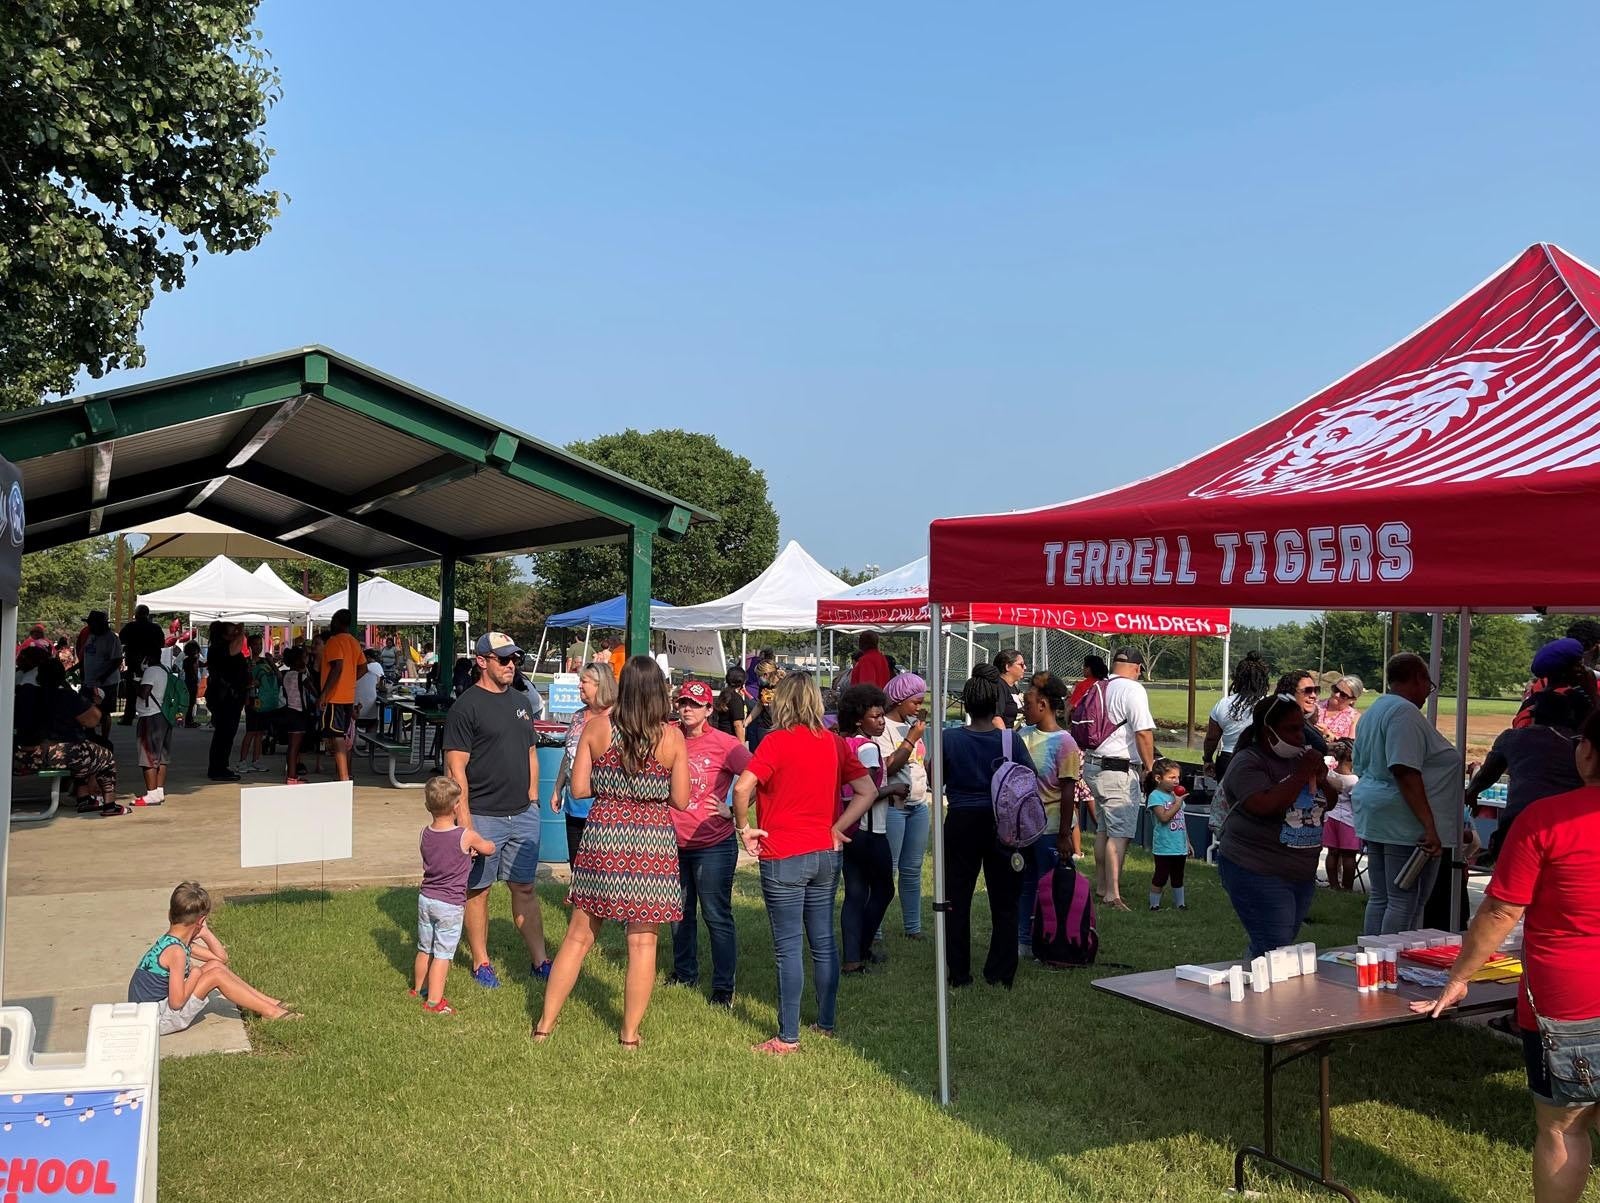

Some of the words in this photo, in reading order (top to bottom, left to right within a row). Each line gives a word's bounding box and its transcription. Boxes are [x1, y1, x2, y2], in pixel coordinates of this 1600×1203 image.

[1043, 535, 1196, 586] TERRELL
[1213, 521, 1413, 584] TIGERS
[829, 608, 869, 622] LIFTING
[888, 606, 954, 621] CHILDN
[1081, 611, 1109, 627] UP
[1115, 612, 1211, 632] CHILDREN
